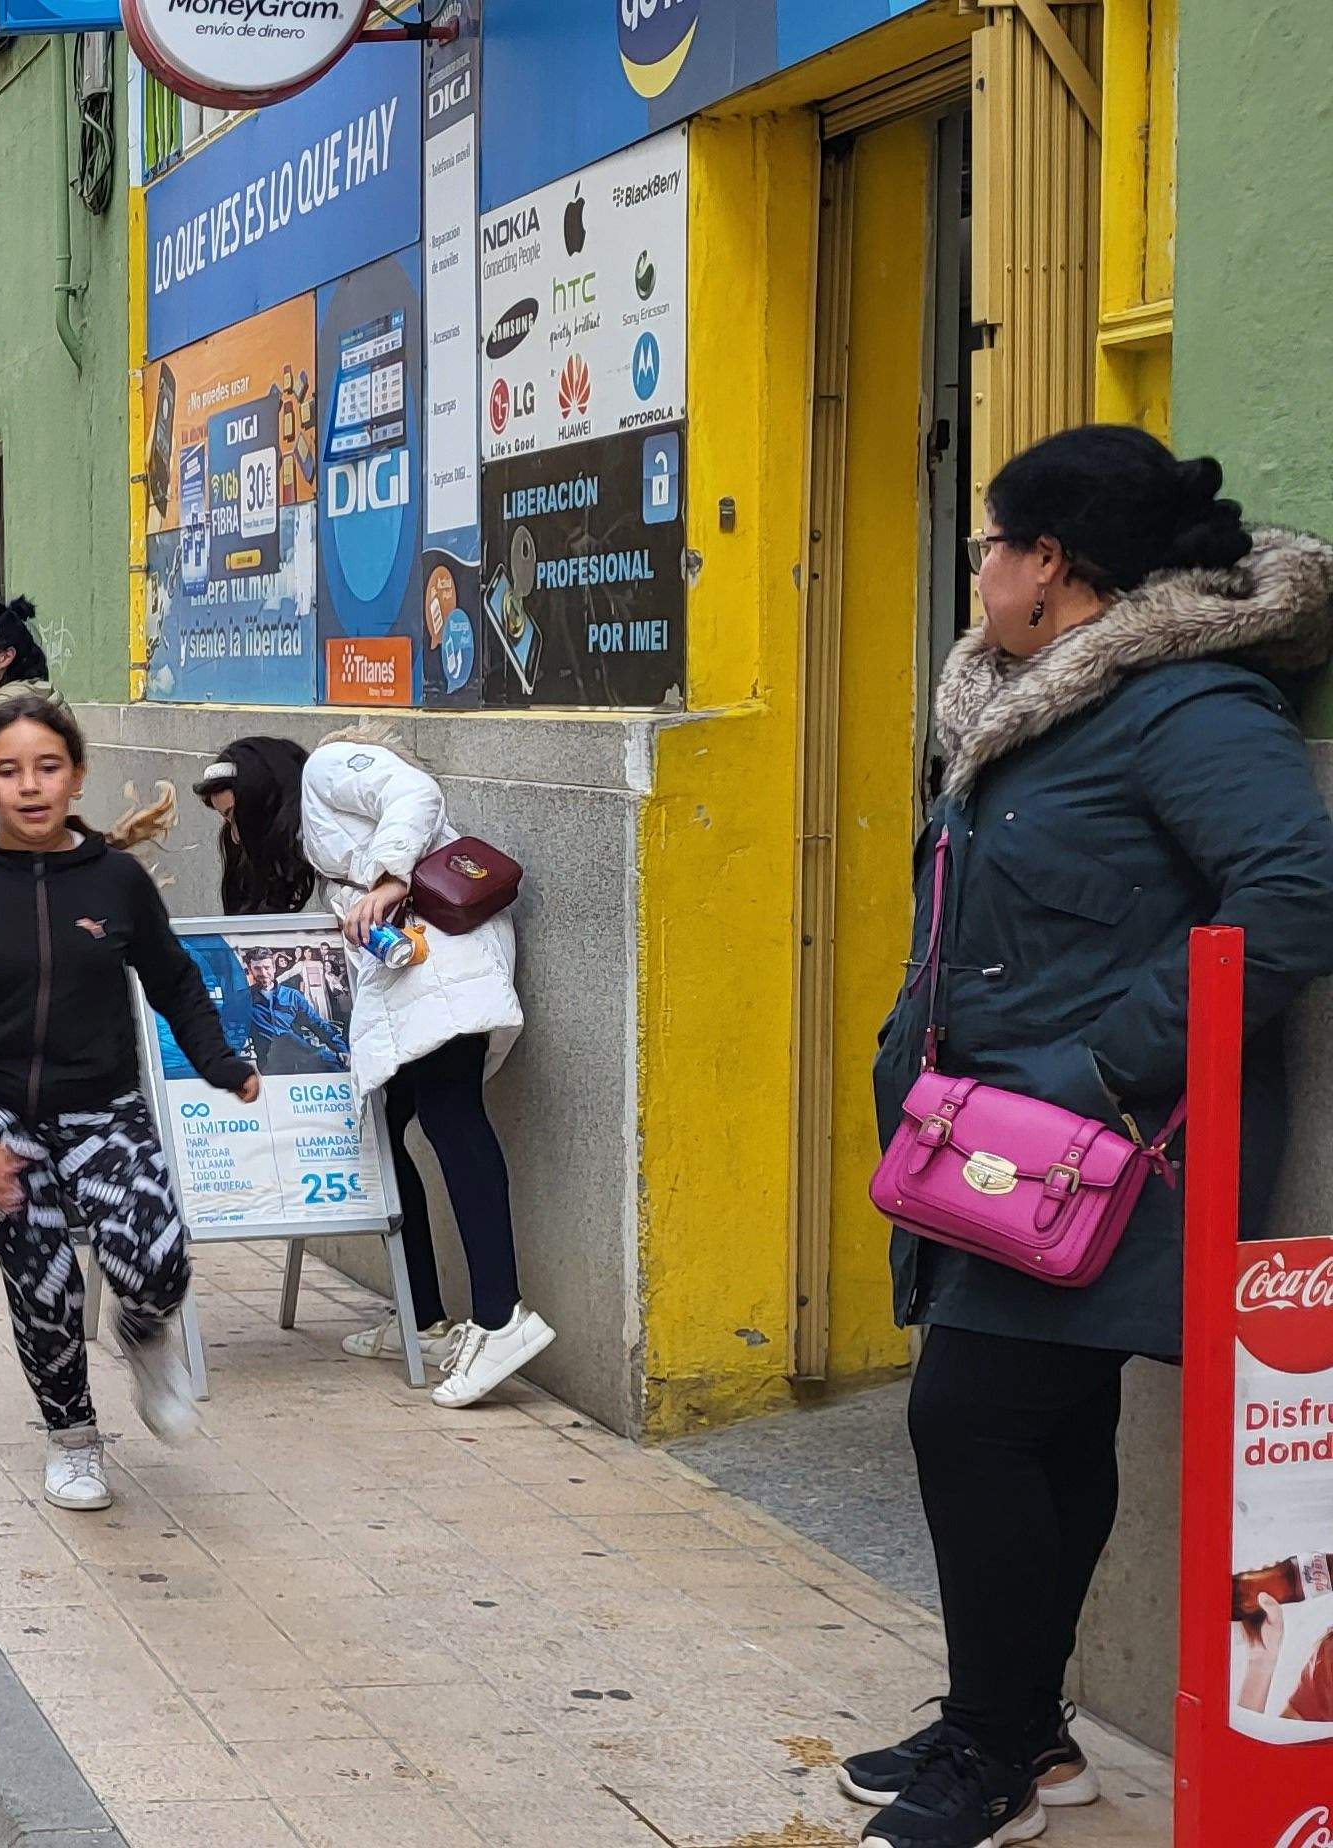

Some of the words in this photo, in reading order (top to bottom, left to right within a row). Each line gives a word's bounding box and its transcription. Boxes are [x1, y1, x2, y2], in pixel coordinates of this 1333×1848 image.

[195, 22, 234, 36] envío
[237, 23, 257, 37] de
[258, 24, 306, 39] dinero
[429, 70, 471, 119] DIGI
[155, 235, 173, 294] LO
[175, 211, 208, 282] QUE
[210, 191, 241, 263] VES
[244, 177, 266, 246] ES
[269, 161, 293, 232] LO
[297, 130, 343, 214] QUE
[345, 96, 398, 191] HAY
[625, 169, 682, 207] BlackBerry
[483, 207, 541, 253] NOKIA
[483, 249, 518, 280] Connecting
[518, 239, 541, 268] People
[491, 312, 535, 344] SAMSUNG
[622, 311, 640, 327] Sony
[640, 303, 670, 321] Ericsson
[549, 321, 572, 351] quietly
[574, 311, 601, 336] brilliant
[231, 376, 250, 397] usar
[513, 381, 536, 418] LG
[226, 414, 258, 446] DIGI
[558, 420, 592, 441] HUAWEI
[619, 406, 674, 430] MOTOROLA
[490, 438, 512, 458] Life's
[514, 435, 536, 453] Good
[221, 469, 239, 501] 1Gb
[327, 450, 410, 518] DIGI
[503, 471, 599, 521] LIBERACIÓN
[211, 504, 240, 536] FIBRA
[536, 549, 655, 590] PROFESIONAL
[189, 620, 226, 659] siente
[245, 616, 302, 657] libertad
[588, 622, 624, 653] POR
[629, 620, 669, 652] IMEI
[353, 654, 395, 684] Titanes
[289, 1084, 351, 1102] GIGAS
[293, 1102, 352, 1114] ILIMITADOS
[183, 1120, 260, 1136] ILIMITODO
[186, 1138, 210, 1148] PARA
[295, 1135, 359, 1148] LLAMADAS
[187, 1148, 230, 1159] NAVEGAR
[189, 1160, 196, 1170] Y
[197, 1159, 236, 1170] LLAMAR
[297, 1146, 360, 1158] ILIMITADAS
[191, 1171, 217, 1181] TODO
[219, 1170, 231, 1180] LO
[193, 1182, 212, 1193] QUE
[301, 1172, 362, 1204] 25€
